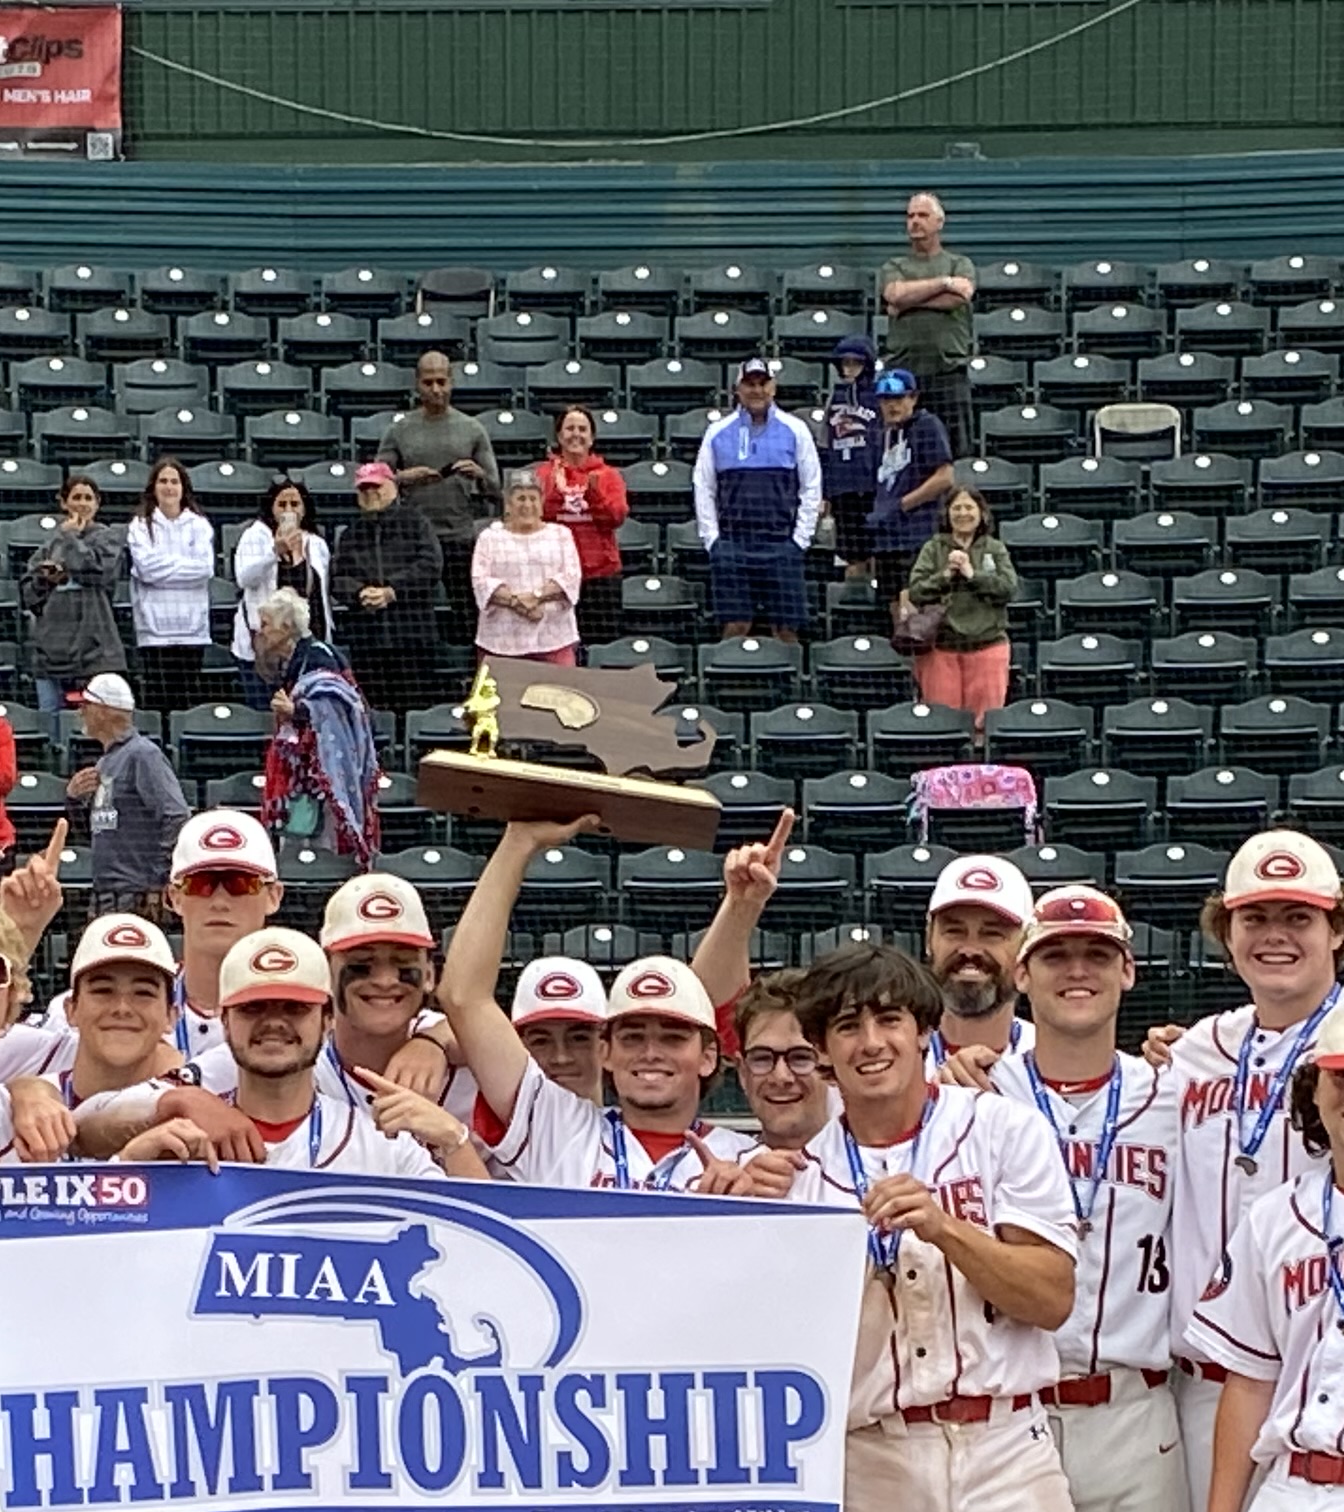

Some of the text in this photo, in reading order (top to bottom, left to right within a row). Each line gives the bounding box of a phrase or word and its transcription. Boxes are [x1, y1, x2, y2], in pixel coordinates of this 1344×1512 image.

[202, 826, 244, 851] G
[959, 867, 998, 891] G
[1256, 853, 1302, 880] G
[359, 890, 402, 919] G
[105, 925, 147, 948] G
[250, 947, 295, 972] G
[538, 973, 579, 999] G
[629, 971, 674, 999] G
[55, 1174, 97, 1206] IX
[100, 1176, 147, 1205] 50
[1136, 1233, 1171, 1294] 13
[215, 1248, 396, 1308] MIAA
